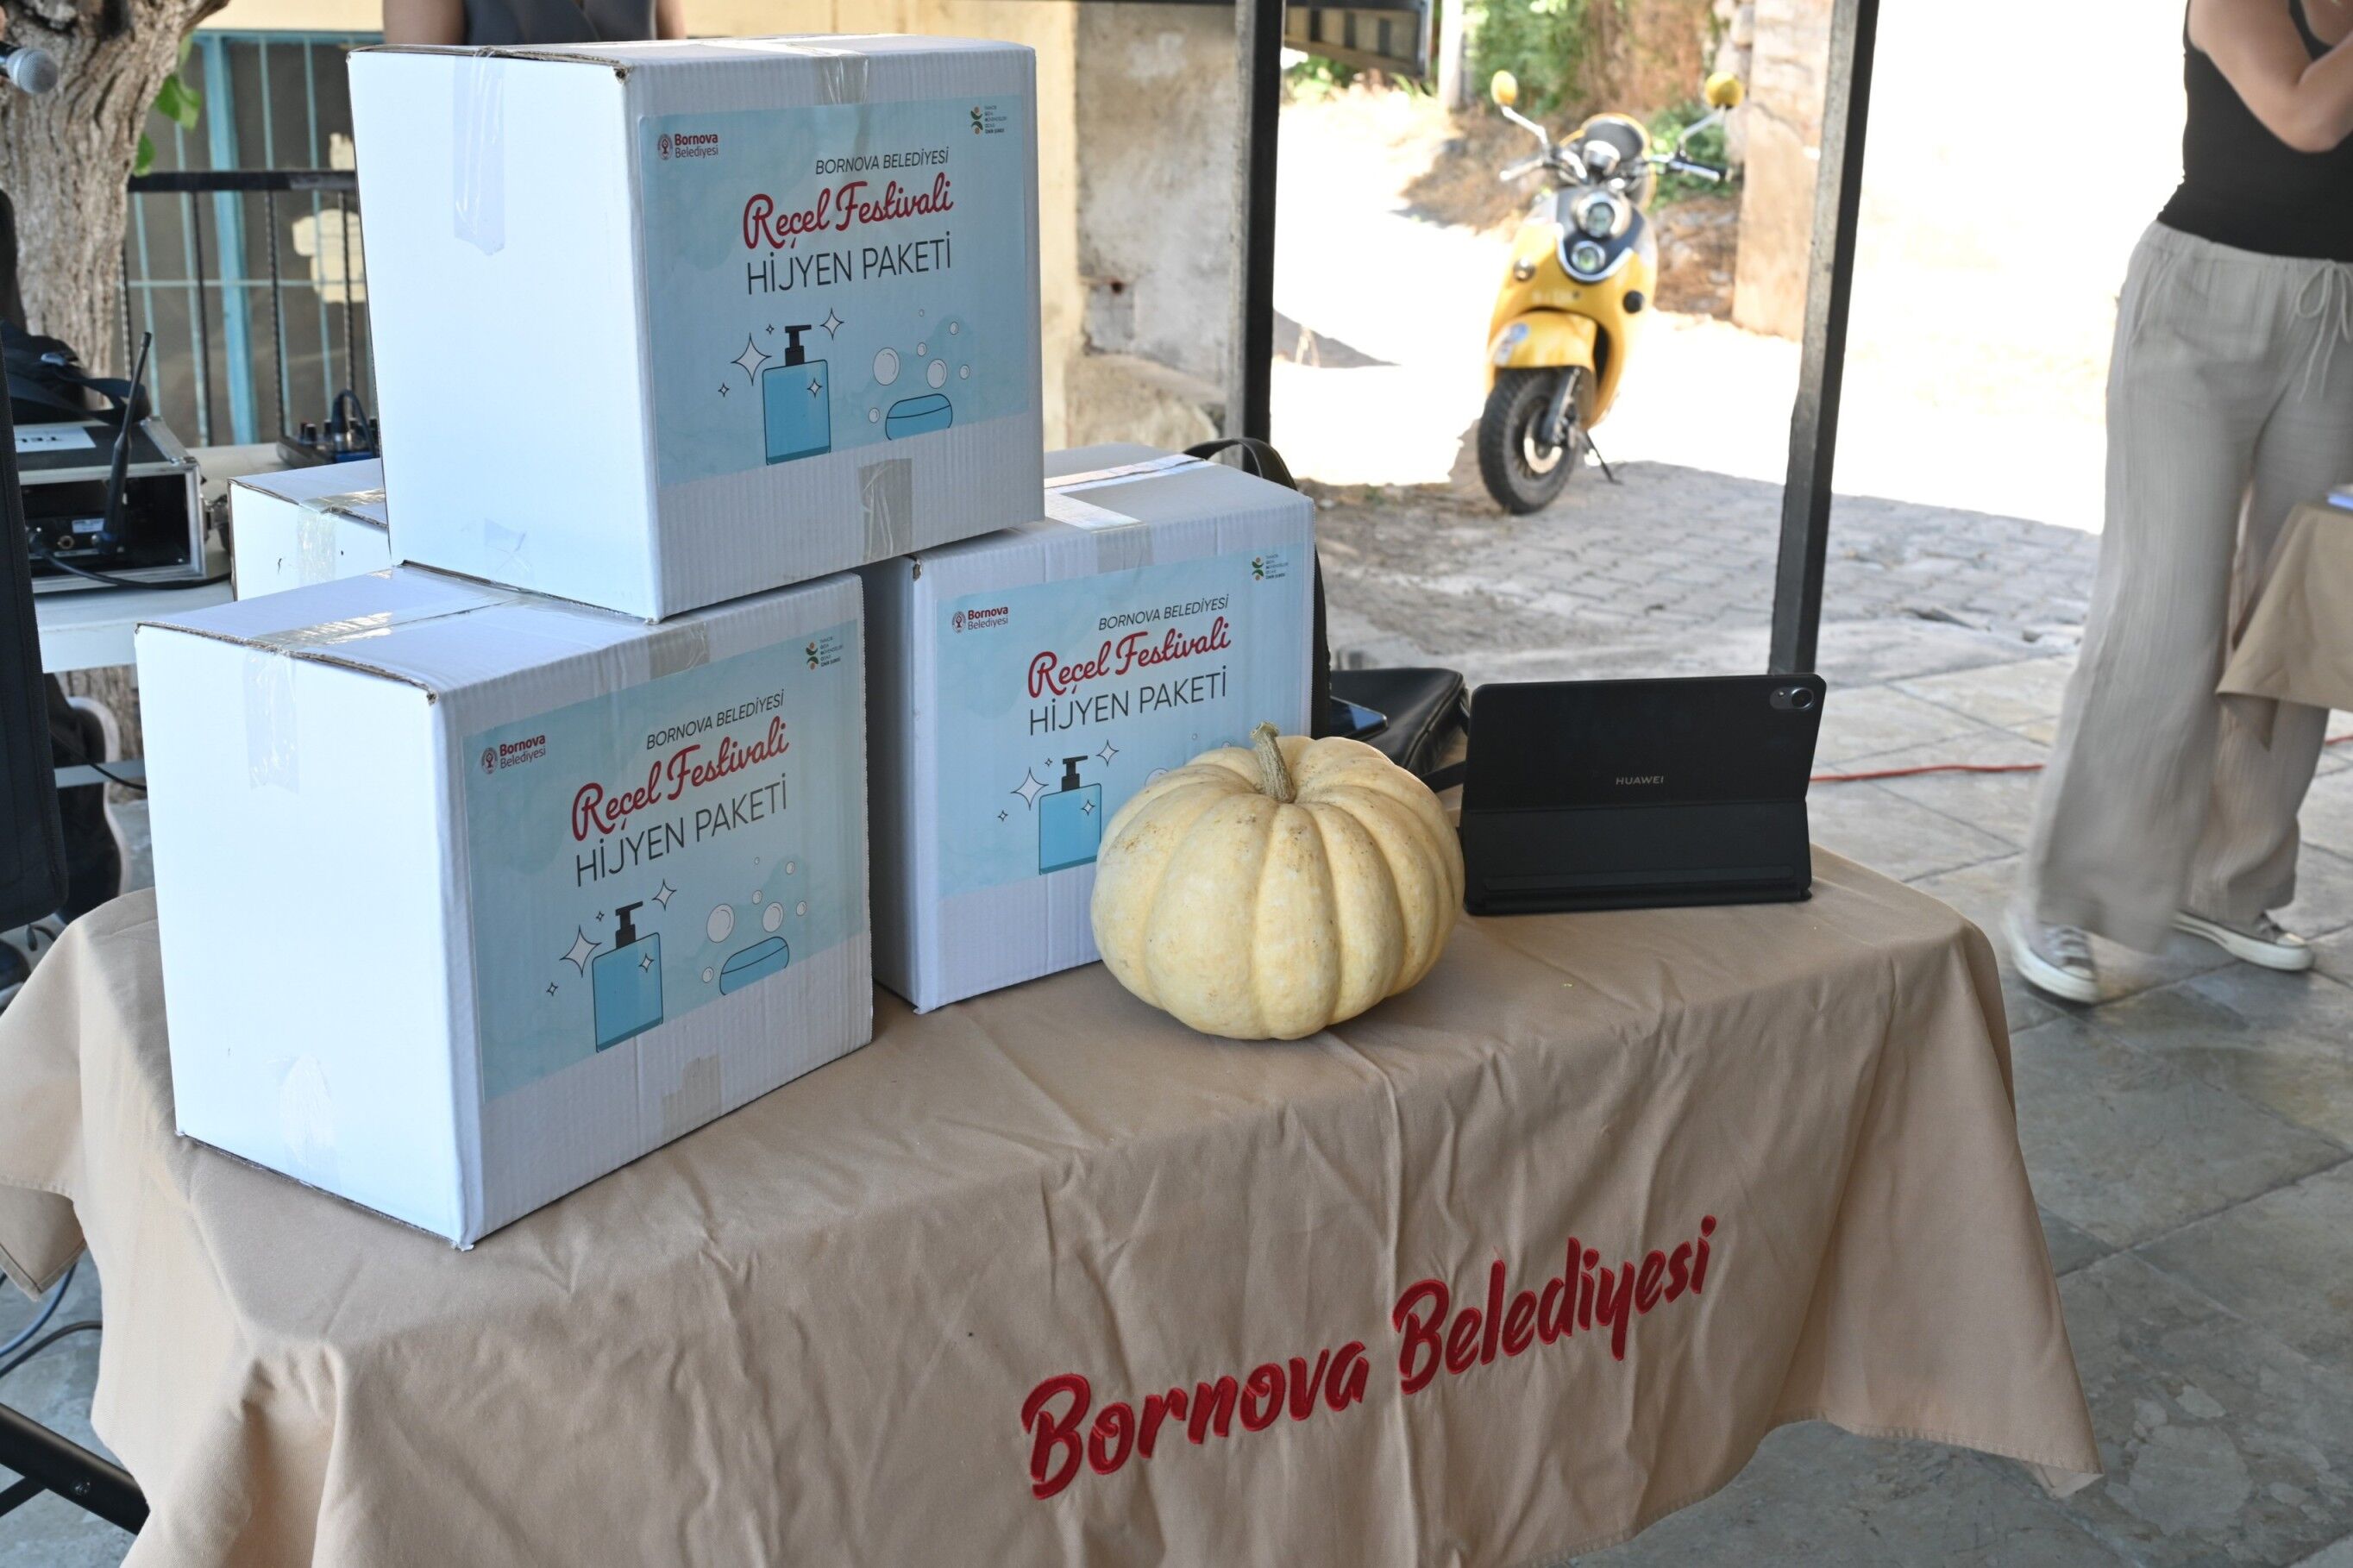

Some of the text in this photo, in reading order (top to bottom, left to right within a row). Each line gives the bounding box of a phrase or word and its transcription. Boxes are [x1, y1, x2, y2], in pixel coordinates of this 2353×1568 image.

[675, 133, 718, 147] Bornova
[675, 145, 718, 160] Belediyesi
[815, 146, 950, 175] BORNOVA BELEDİYESİ
[743, 172, 954, 249] Reçel Festivali
[747, 230, 951, 295] HİJYEN PAKETİ
[968, 605, 1008, 621] Bornova
[968, 616, 1008, 630] Belediyesi
[1098, 593, 1230, 630] BORNOVA BELEDİYESİ
[1027, 616, 1232, 699] Reçel Festivali
[646, 688, 785, 750] BORNOVA BELEDİYESİ
[1030, 665, 1227, 736] HİJYEN PAKETİ
[499, 733, 546, 757] Bornova
[500, 747, 547, 769] Belediyesi
[571, 716, 790, 842] Reçel Festivali
[1616, 775, 1665, 786] HUAWEI
[576, 772, 787, 887] HİJYEN PAKETİ
[1020, 1214, 1717, 1501] Bornova Belediyesi
